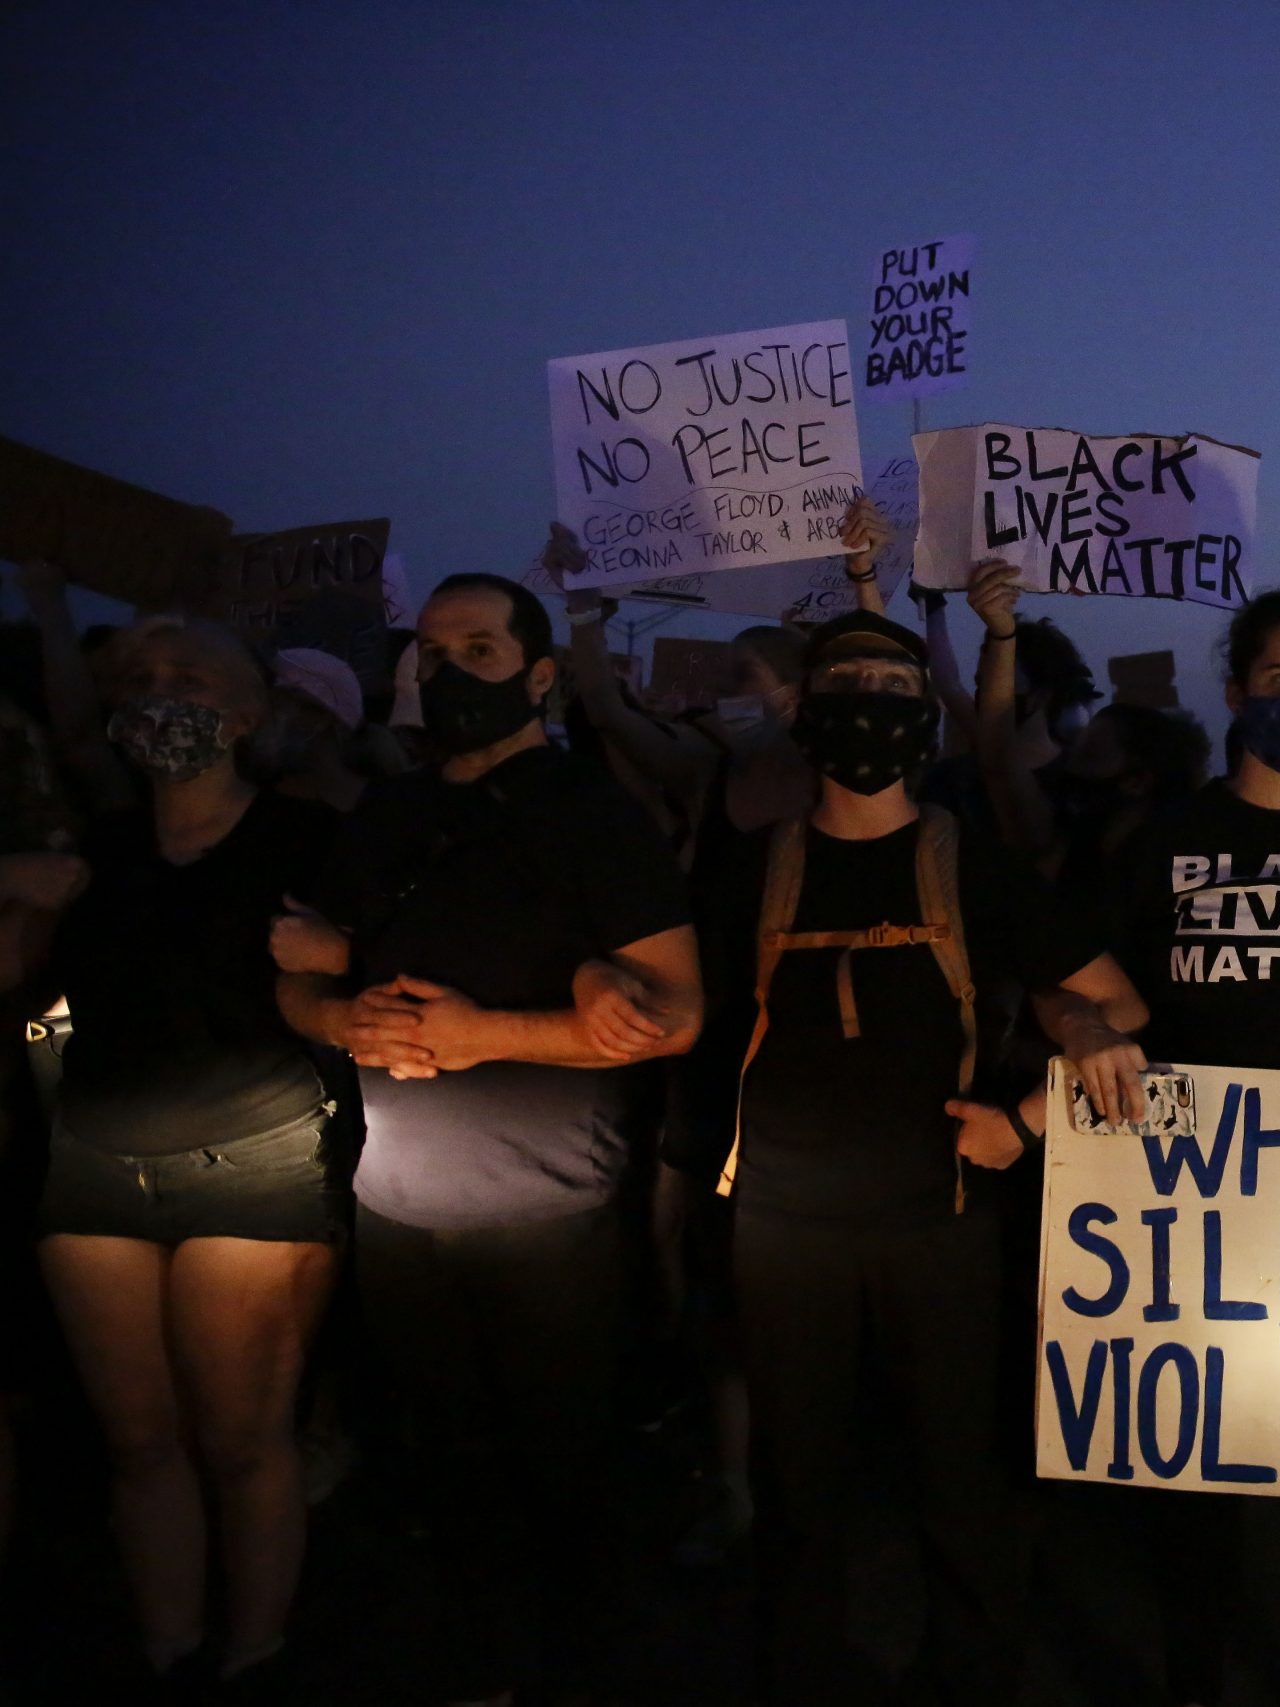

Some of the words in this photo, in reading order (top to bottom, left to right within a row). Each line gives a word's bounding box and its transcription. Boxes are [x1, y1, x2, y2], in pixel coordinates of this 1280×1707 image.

[882, 241, 945, 284] PUT
[874, 270, 969, 315] DOWN
[870, 306, 954, 349] YOUR
[576, 360, 662, 425] NO
[675, 342, 852, 417] JUSTICE
[866, 331, 967, 387] BADGE
[576, 438, 651, 494] NO
[671, 417, 830, 486] PEACE
[984, 430, 1198, 504] BLACK
[584, 502, 701, 545] GEORGE
[984, 485, 1130, 549] LIVES
[585, 539, 683, 573] REONNA
[693, 529, 768, 558] TAYLOR
[1049, 533, 1250, 603] MATTER
